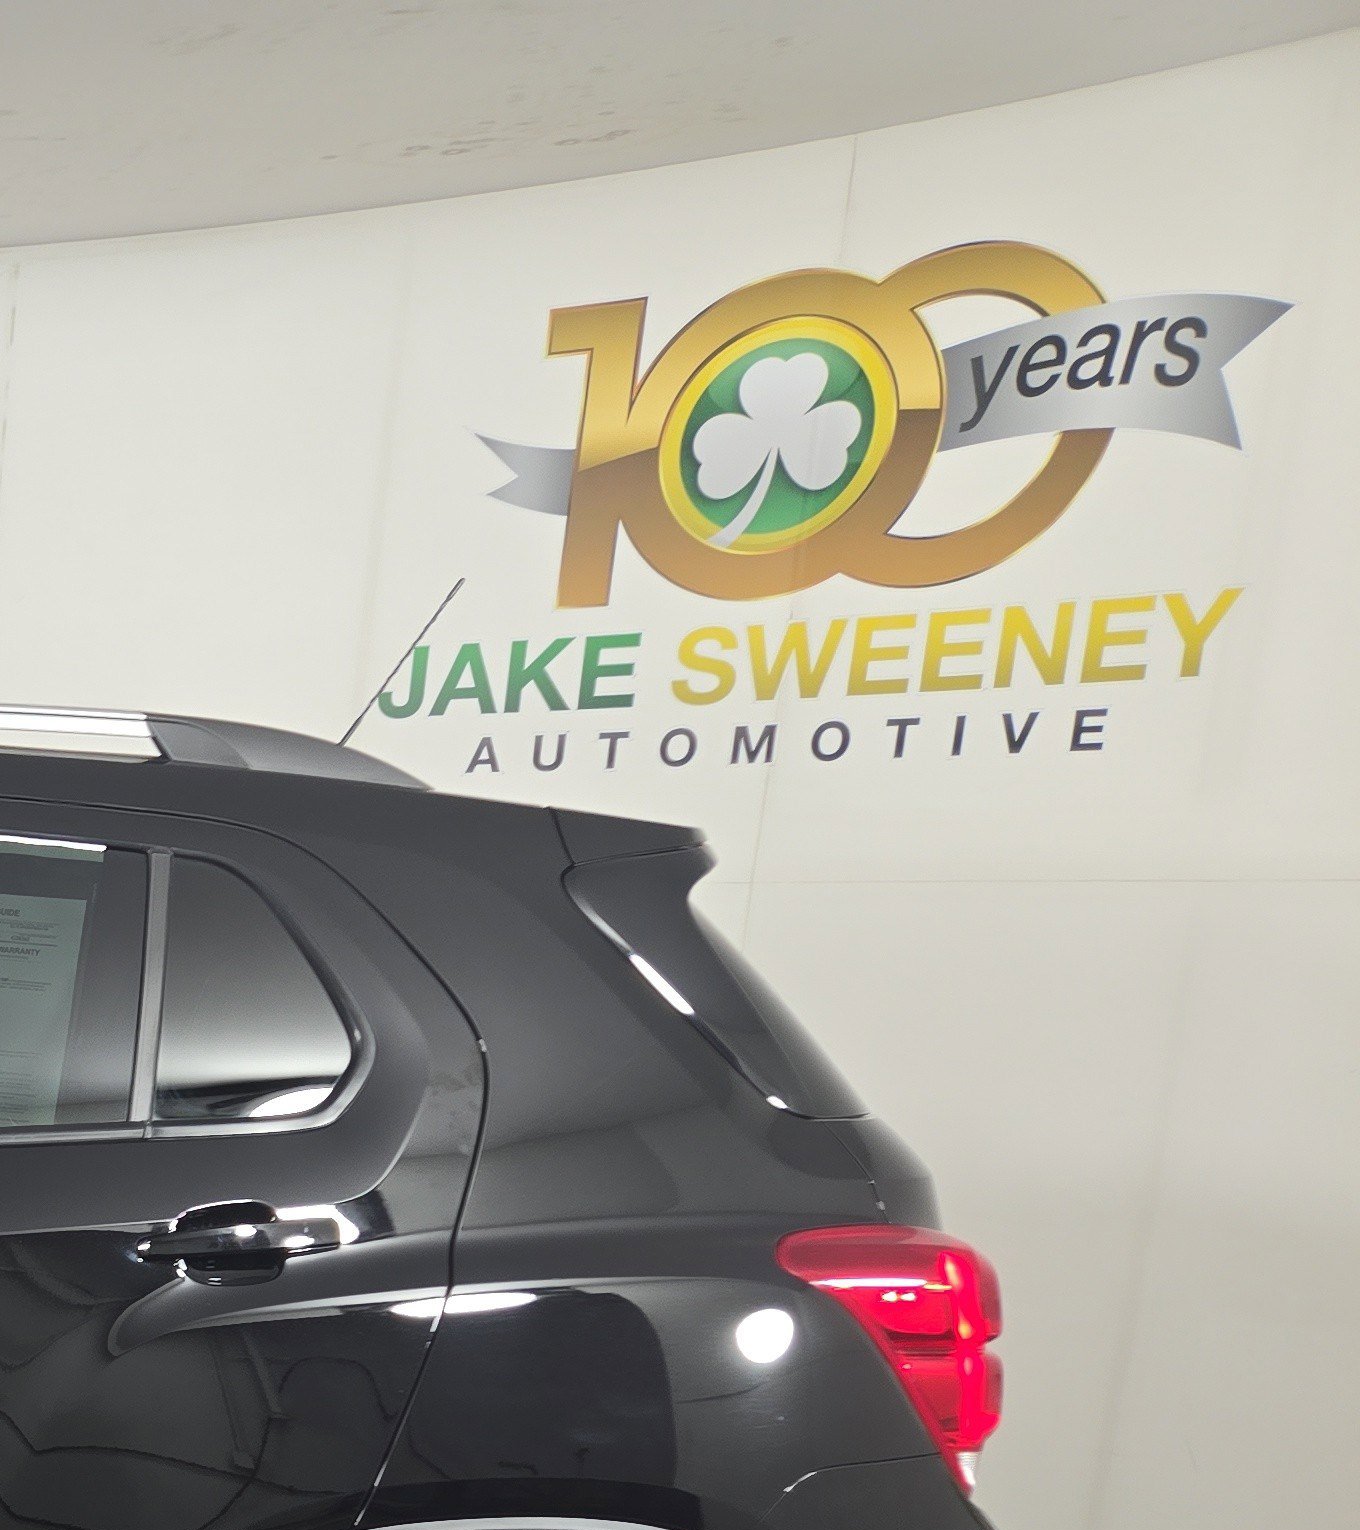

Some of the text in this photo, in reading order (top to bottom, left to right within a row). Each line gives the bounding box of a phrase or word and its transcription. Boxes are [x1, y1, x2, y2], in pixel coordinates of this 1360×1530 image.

[546, 240, 1115, 609] 100
[959, 314, 1207, 433] years
[378, 588, 1245, 719] JAKE SWEENEY
[466, 708, 1110, 775] AUTOMOTIVE
